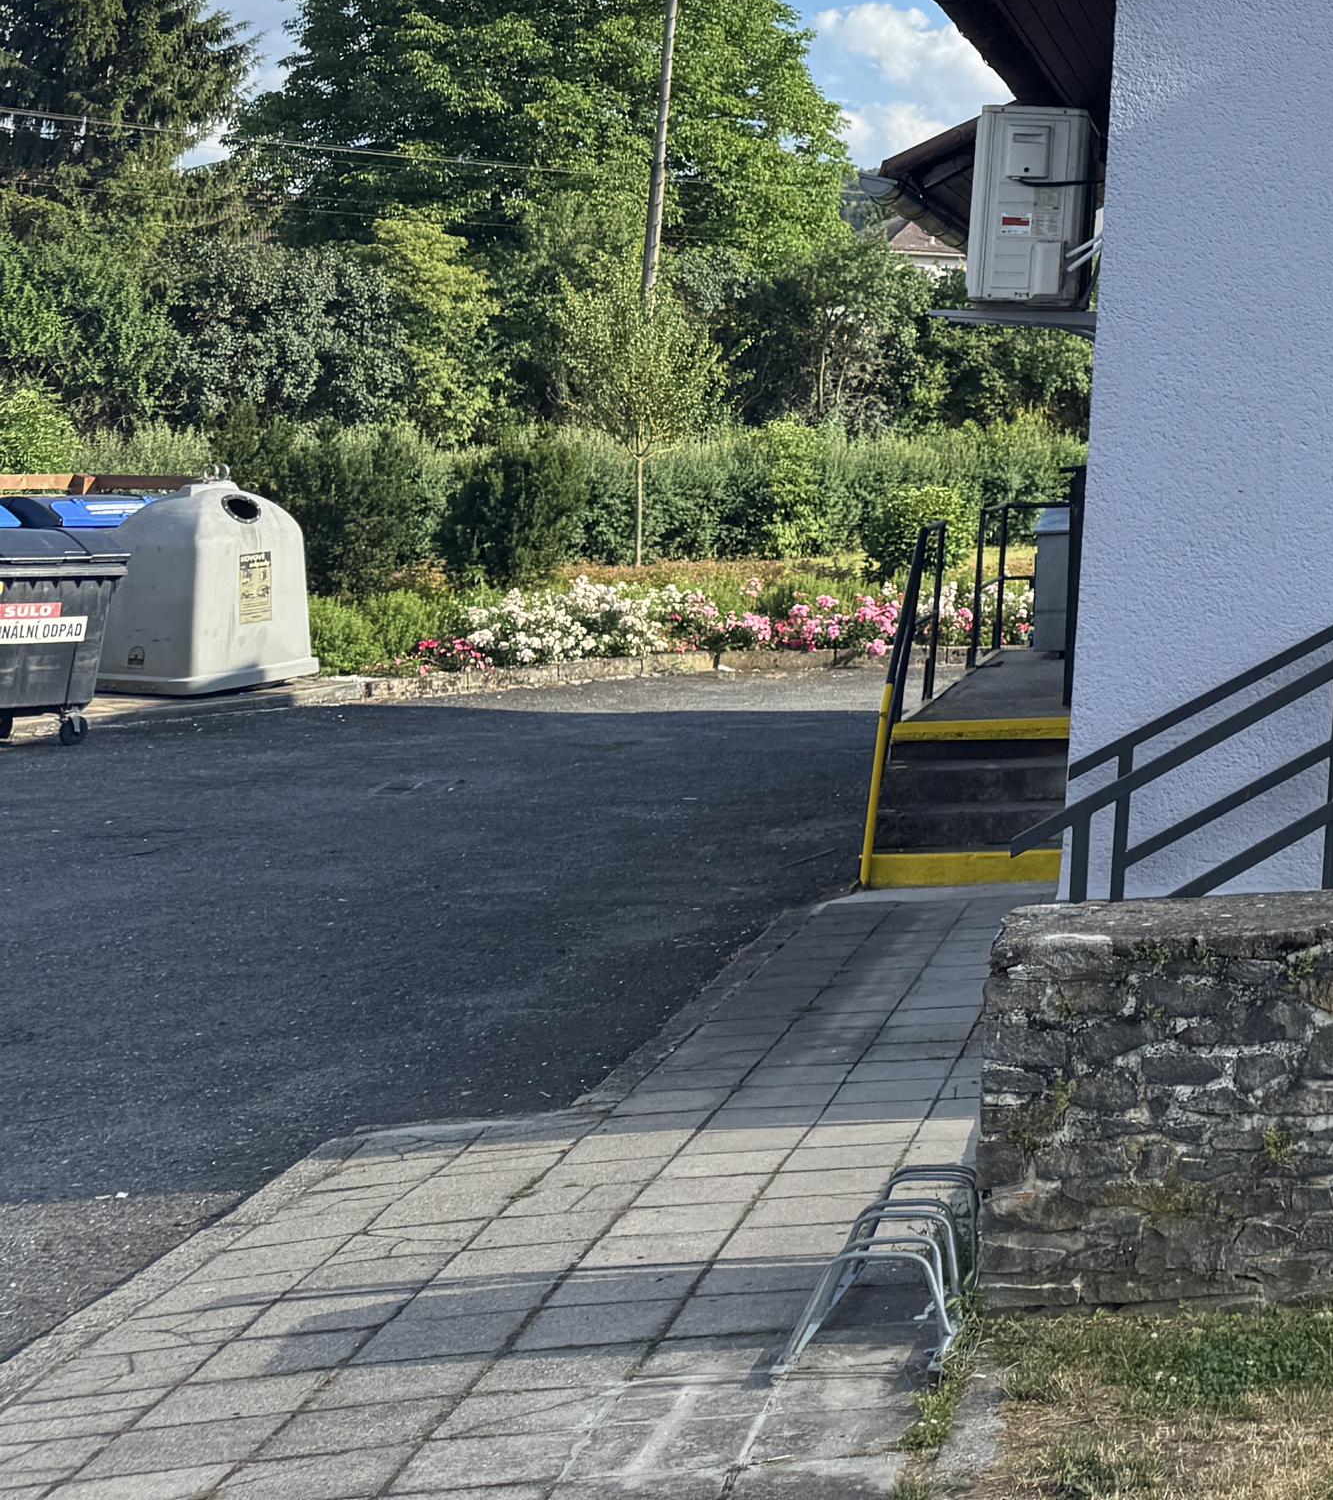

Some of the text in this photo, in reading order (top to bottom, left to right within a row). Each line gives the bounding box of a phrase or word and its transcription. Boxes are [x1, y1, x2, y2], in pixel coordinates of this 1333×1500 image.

[3, 605, 52, 618] SULO
[0, 620, 82, 640] NÁLNÍ ODPAD
